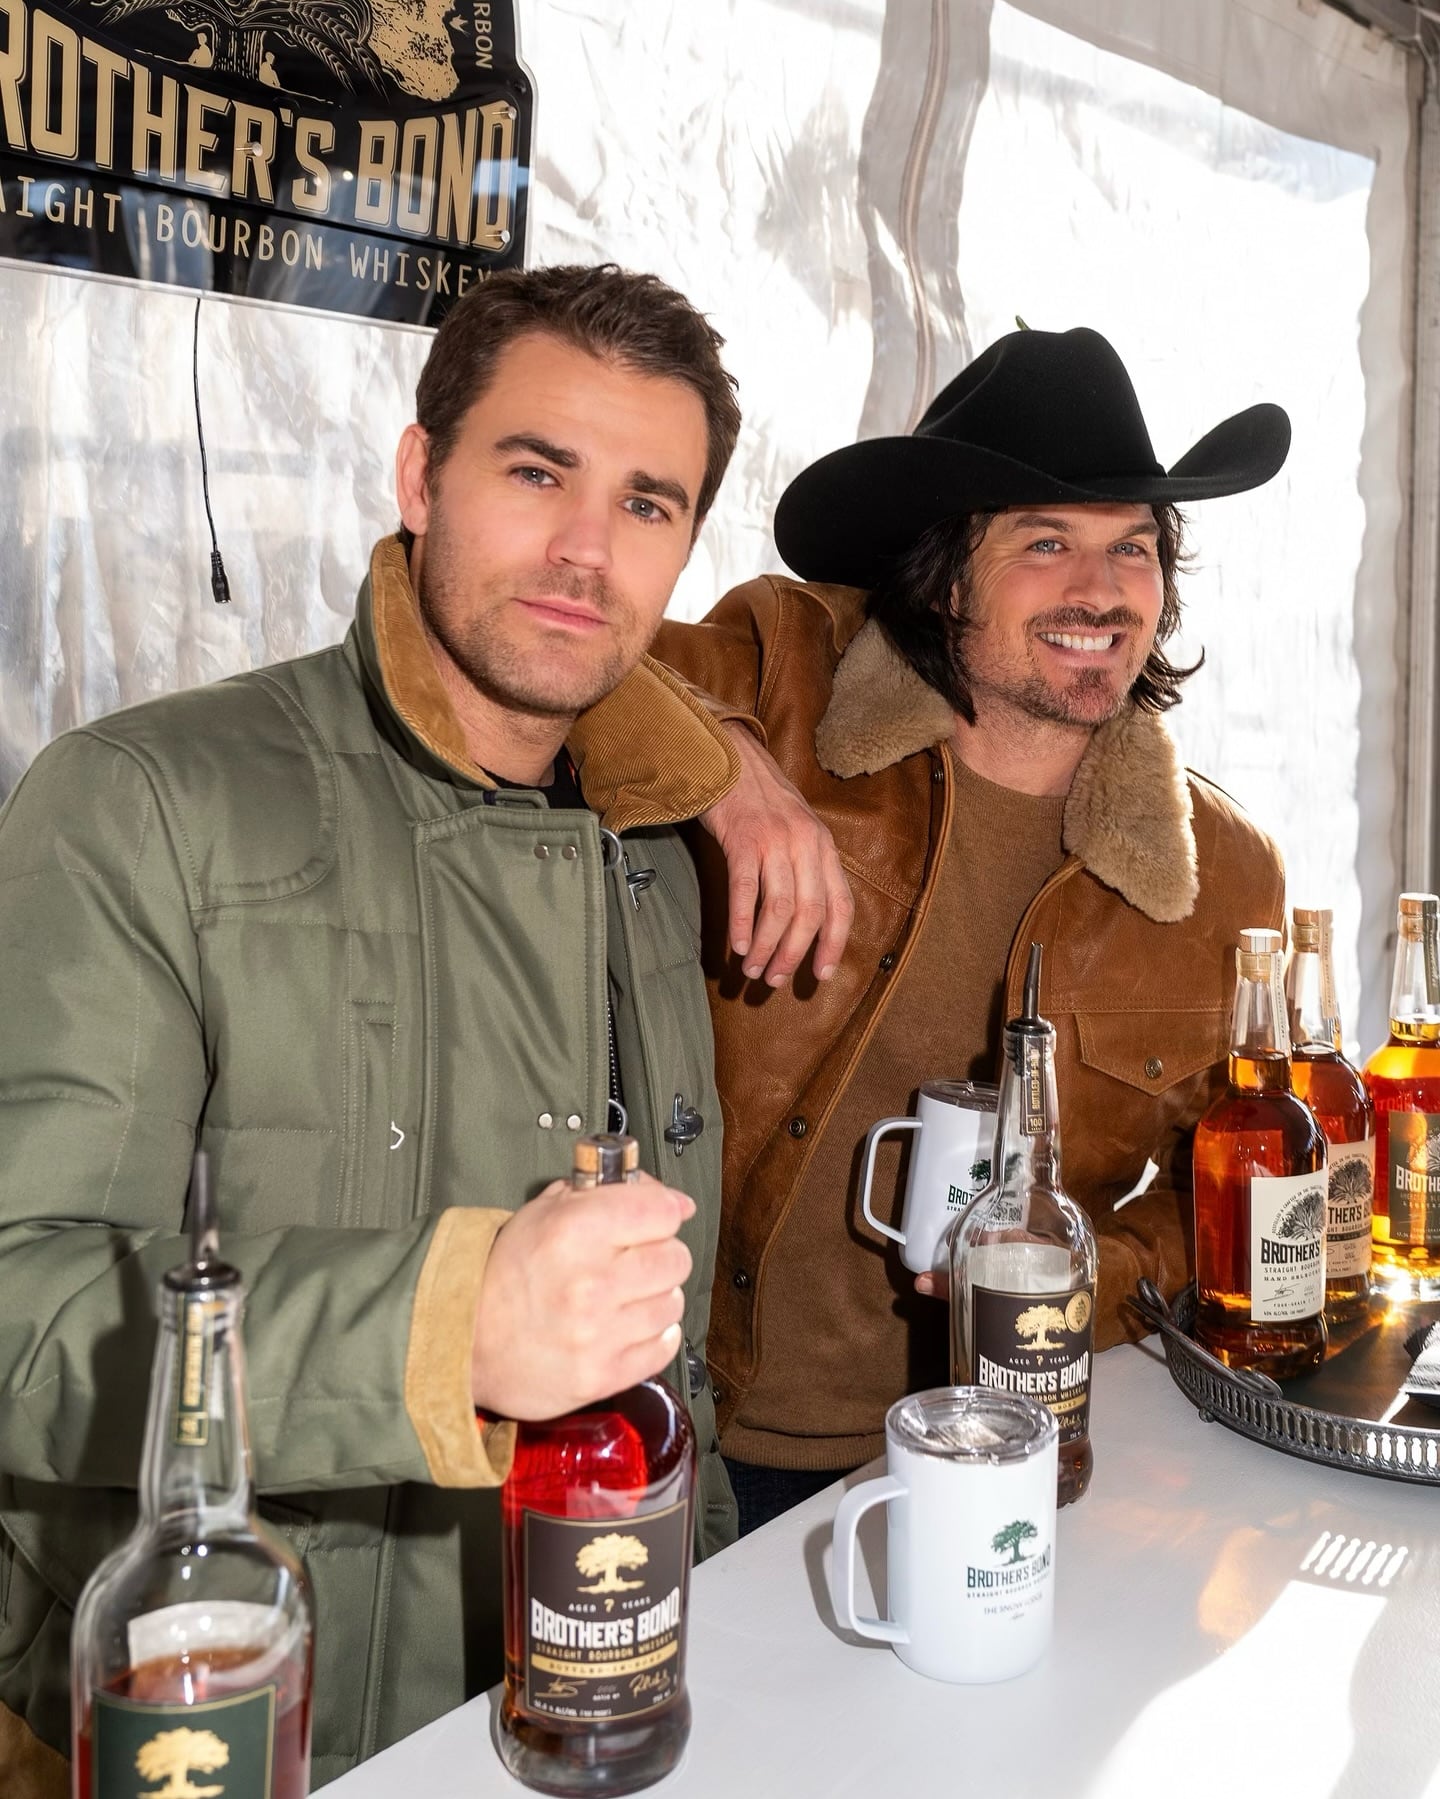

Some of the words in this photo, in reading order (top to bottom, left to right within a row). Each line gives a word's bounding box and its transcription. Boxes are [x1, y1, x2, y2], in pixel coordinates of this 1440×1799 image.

[354, 100, 517, 252] BOND
[156, 205, 324, 270] BOURBON
[1264, 1265, 1298, 1274] STRAIGHT
[979, 1353, 1058, 1393] BROTHER'S
[1060, 1350, 1089, 1390] BOND
[1009, 1357, 1030, 1366] AGED
[1049, 1354, 1071, 1365] YEARS
[967, 1565, 1030, 1588] BROTHER'S
[568, 1602, 597, 1613] AGED
[604, 1598, 615, 1613] 7
[622, 1596, 652, 1610] YEARS
[531, 1597, 635, 1649] BROTHER'S
[637, 1586, 681, 1643] BOND
[535, 1643, 583, 1660] STRAIGHT
[588, 1646, 634, 1661] BOURBON
